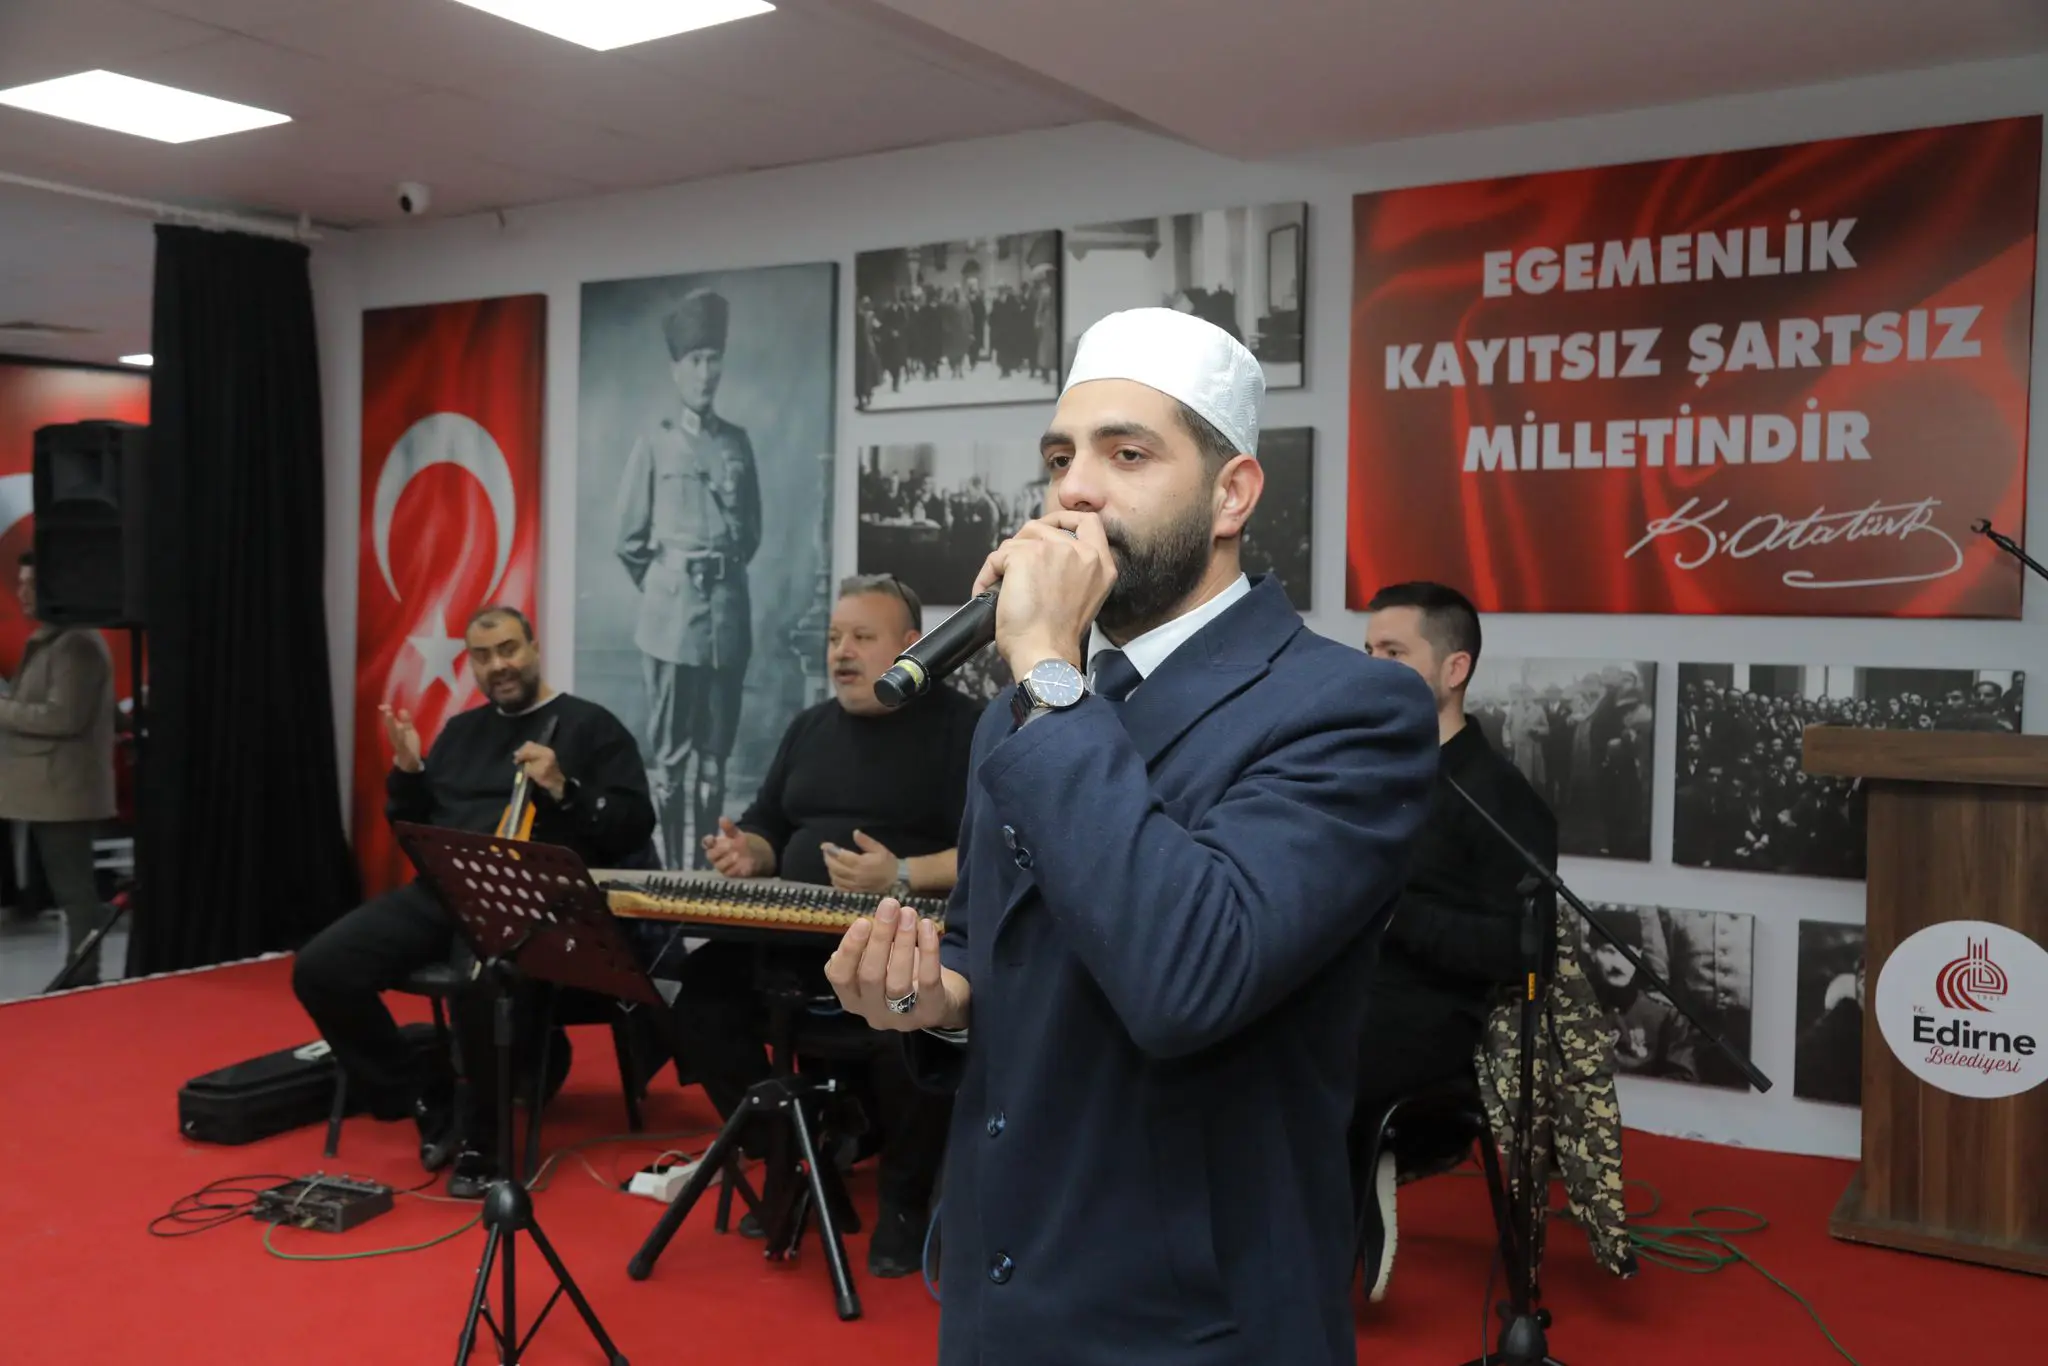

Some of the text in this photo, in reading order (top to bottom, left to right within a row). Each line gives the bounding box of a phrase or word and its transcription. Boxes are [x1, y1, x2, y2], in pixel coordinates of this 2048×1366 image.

[1482, 208, 1858, 298] EGEMENLİK
[1384, 305, 1983, 390] KAYITSIZ ŞARTSIZ
[1463, 397, 1871, 473] MİLLETİNDİR
[1913, 1015, 2036, 1055] Edirne
[1925, 1046, 2021, 1074] Belediyesi
